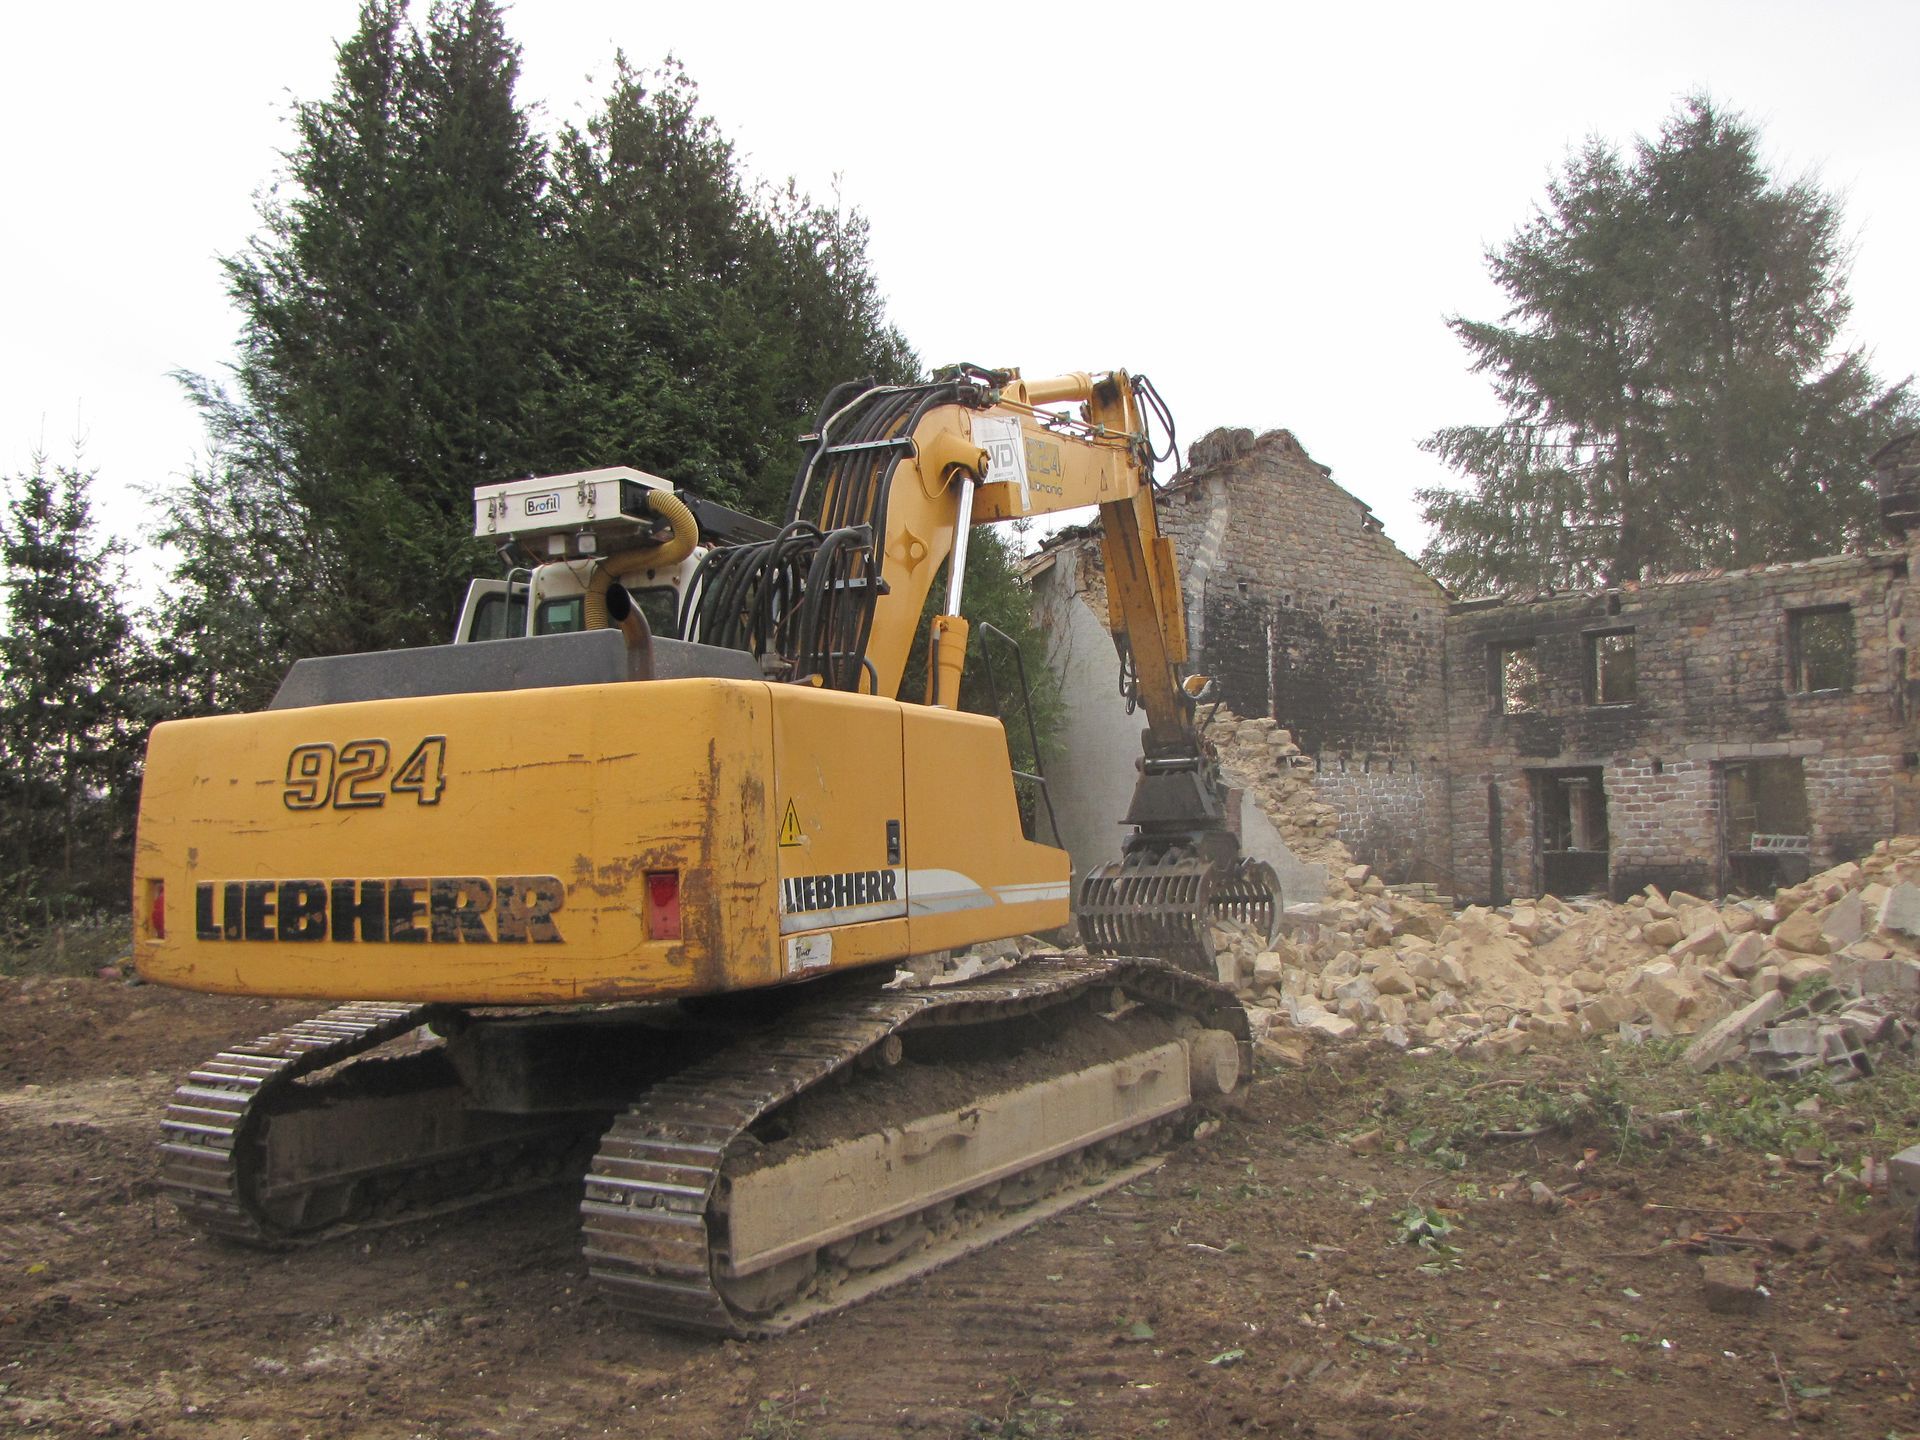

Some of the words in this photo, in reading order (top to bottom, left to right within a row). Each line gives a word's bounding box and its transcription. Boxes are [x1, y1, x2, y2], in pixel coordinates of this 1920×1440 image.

[989, 444, 1013, 468] VD
[528, 497, 557, 512] Brofil
[283, 734, 447, 811] 924
[195, 874, 566, 944] LIEBHERR
[783, 869, 898, 914] LIEBHERR
